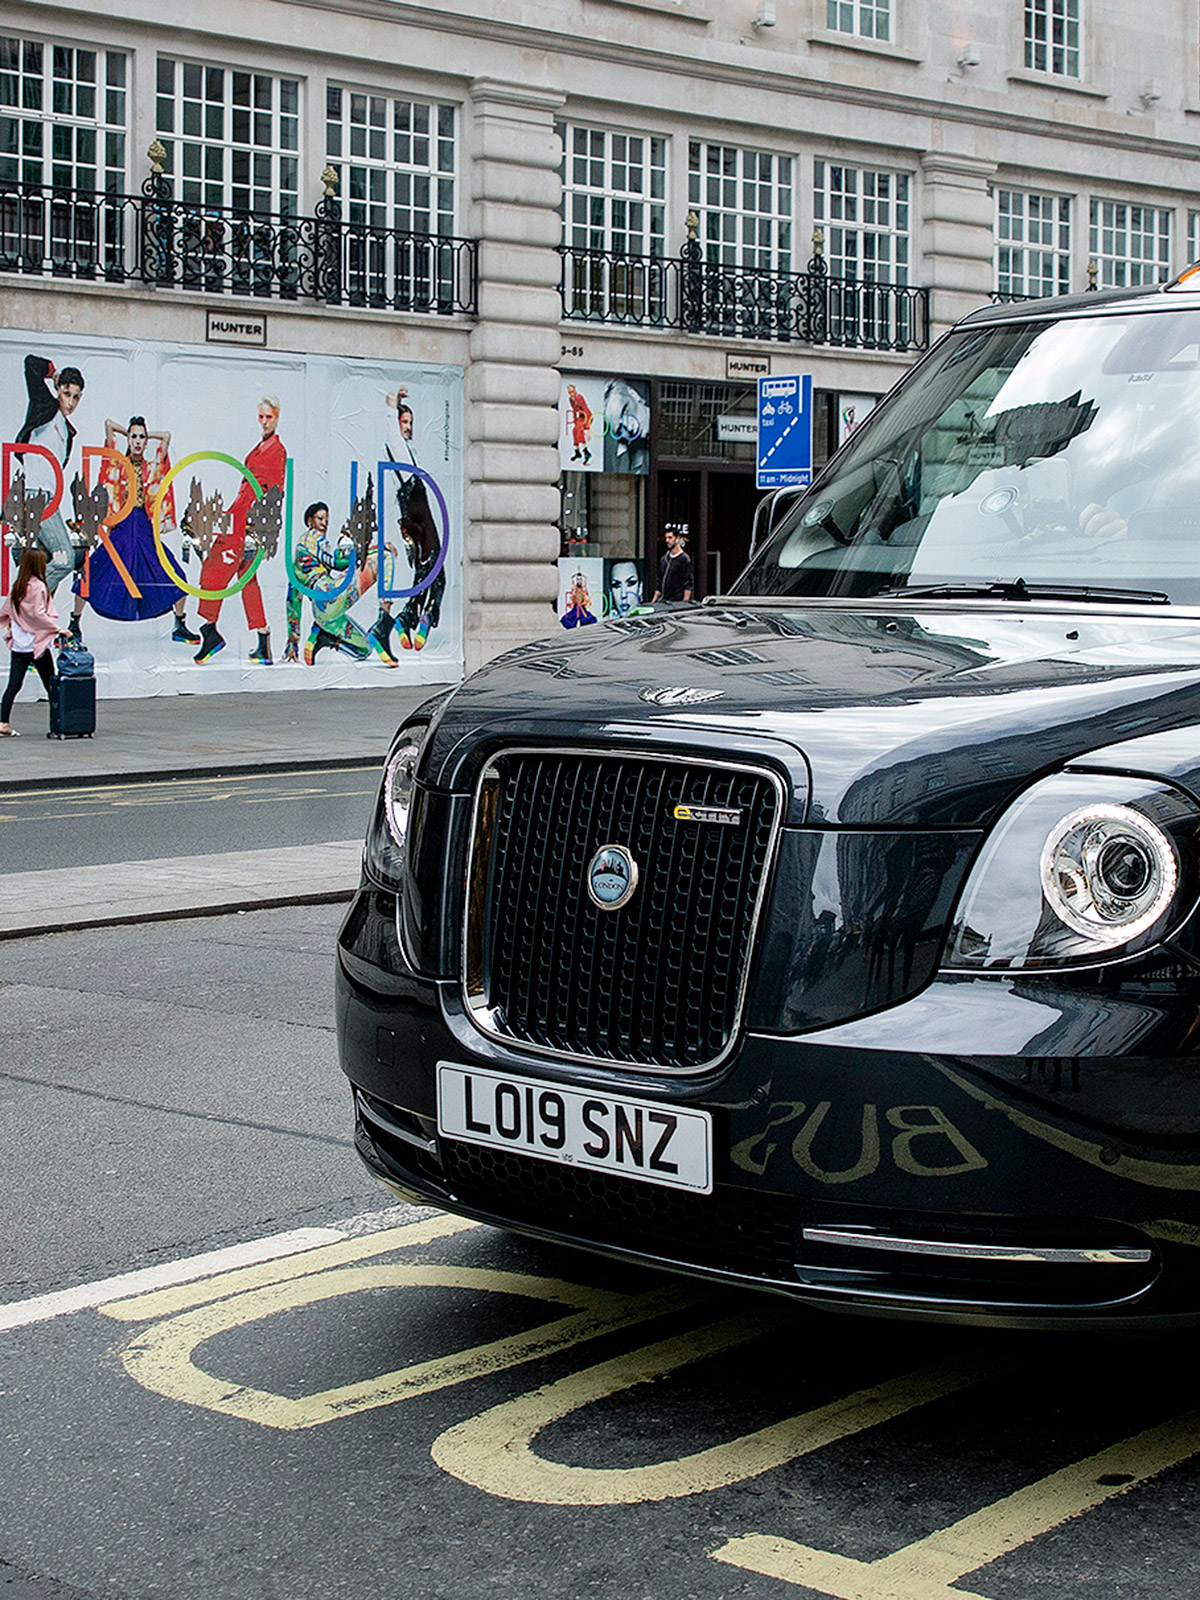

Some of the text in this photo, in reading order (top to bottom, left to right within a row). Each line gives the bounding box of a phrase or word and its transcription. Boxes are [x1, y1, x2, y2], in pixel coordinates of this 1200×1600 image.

[211, 321, 262, 335] HUNTER
[729, 362, 767, 373] HUNTER
[762, 417, 775, 427] taxi
[721, 424, 757, 433] HUNTER
[2, 442, 449, 600] PROUD
[665, 523, 689, 534] SLE
[594, 881, 624, 891] LONDON
[464, 1075, 679, 1175] LO19 SNZ
